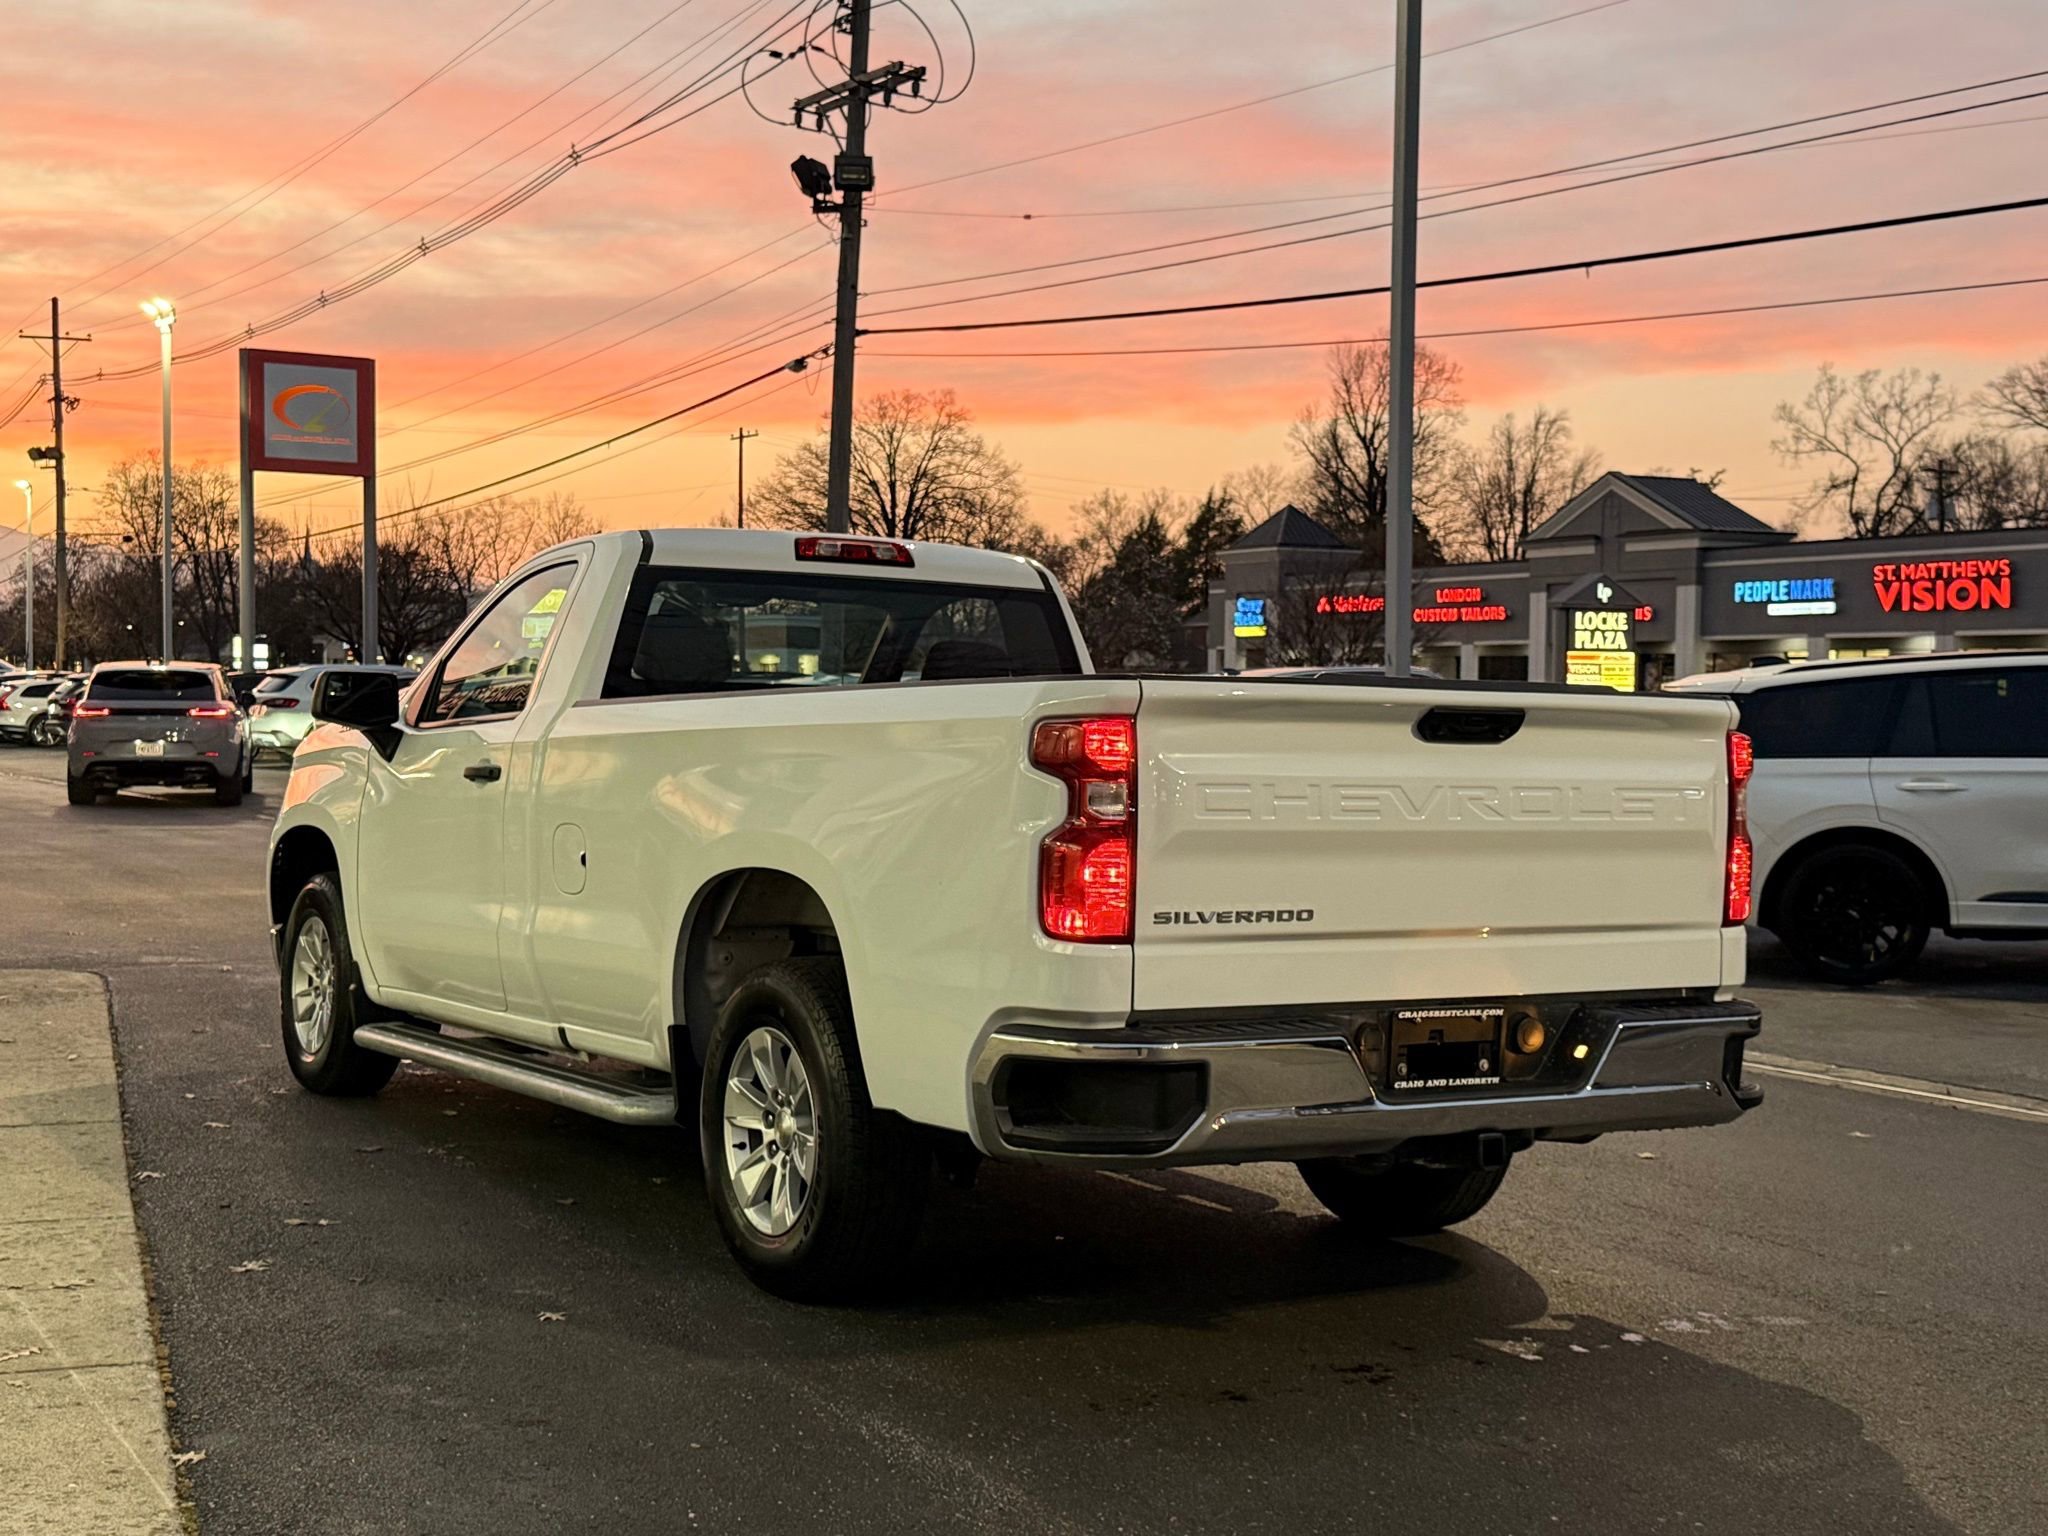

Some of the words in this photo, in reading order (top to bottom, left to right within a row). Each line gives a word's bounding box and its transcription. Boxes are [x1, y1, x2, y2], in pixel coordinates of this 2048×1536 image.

[1873, 564, 1897, 581] ST.
[1900, 559, 2011, 580] MATTHEWS
[1436, 587, 1481, 603] LONDON
[1873, 577, 2011, 612] VISION
[1413, 607, 1458, 622] CUSTOM
[1460, 606, 1506, 622] TAILORS
[1574, 611, 1629, 631] LOCKE
[1574, 630, 1628, 650] PLAZA
[1193, 783, 1706, 822] CHEVROLET
[1152, 908, 1316, 925] SILVERADO
[1398, 1008, 1505, 1019] CRAIGSBESTCARS.COM
[1394, 1080, 1425, 1089] CRAIG
[1425, 1078, 1447, 1088] AND
[1448, 1076, 1500, 1086] LANDRETH
